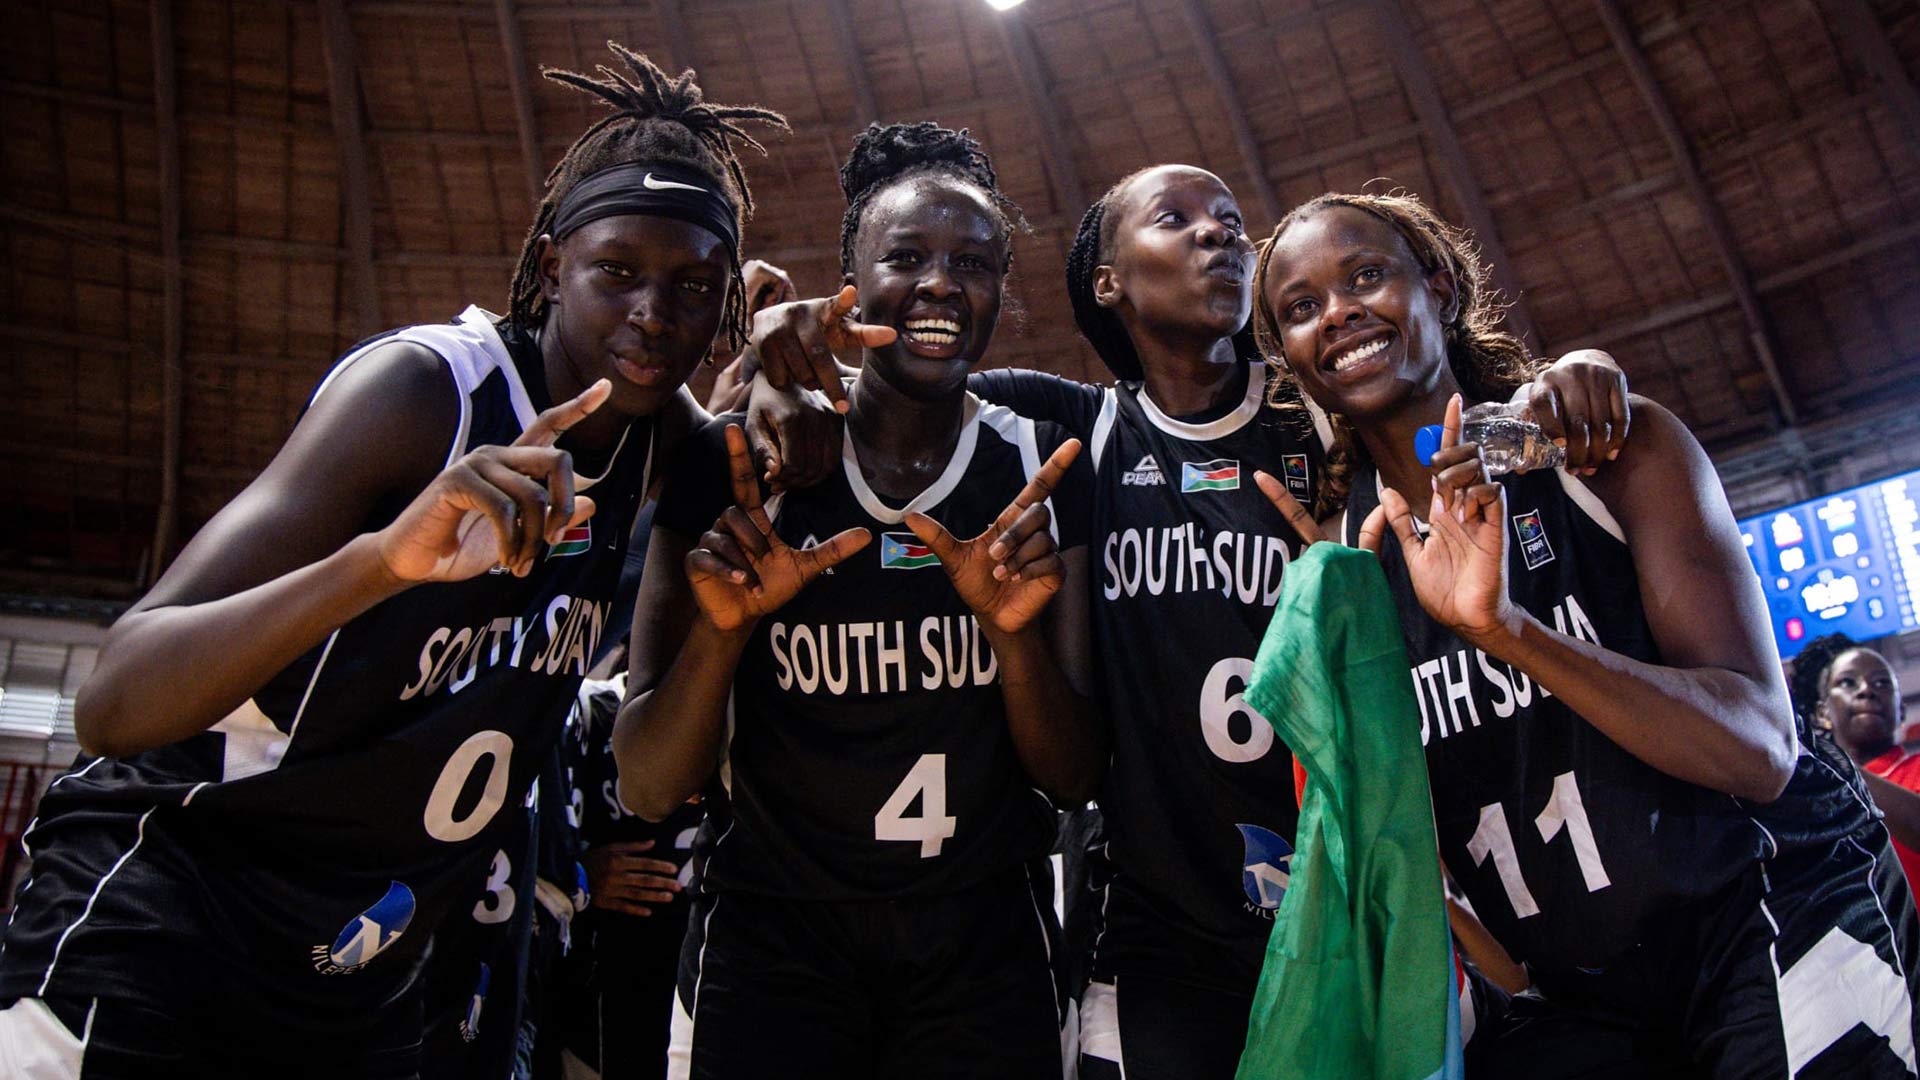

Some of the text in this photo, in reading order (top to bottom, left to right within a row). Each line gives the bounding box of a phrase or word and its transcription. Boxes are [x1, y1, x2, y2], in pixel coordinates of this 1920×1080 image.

[1121, 471, 1167, 486] PEAK
[1103, 522, 1291, 606] SOUTH SUD
[1527, 538, 1544, 554] FIBA
[770, 614, 1000, 695] SOUTH SUD
[1410, 649, 1481, 746] UTH
[1200, 657, 1274, 763] 6
[423, 729, 514, 843] 0
[874, 753, 957, 859] 4
[471, 848, 516, 925] 3
[1466, 770, 1611, 919] 11
